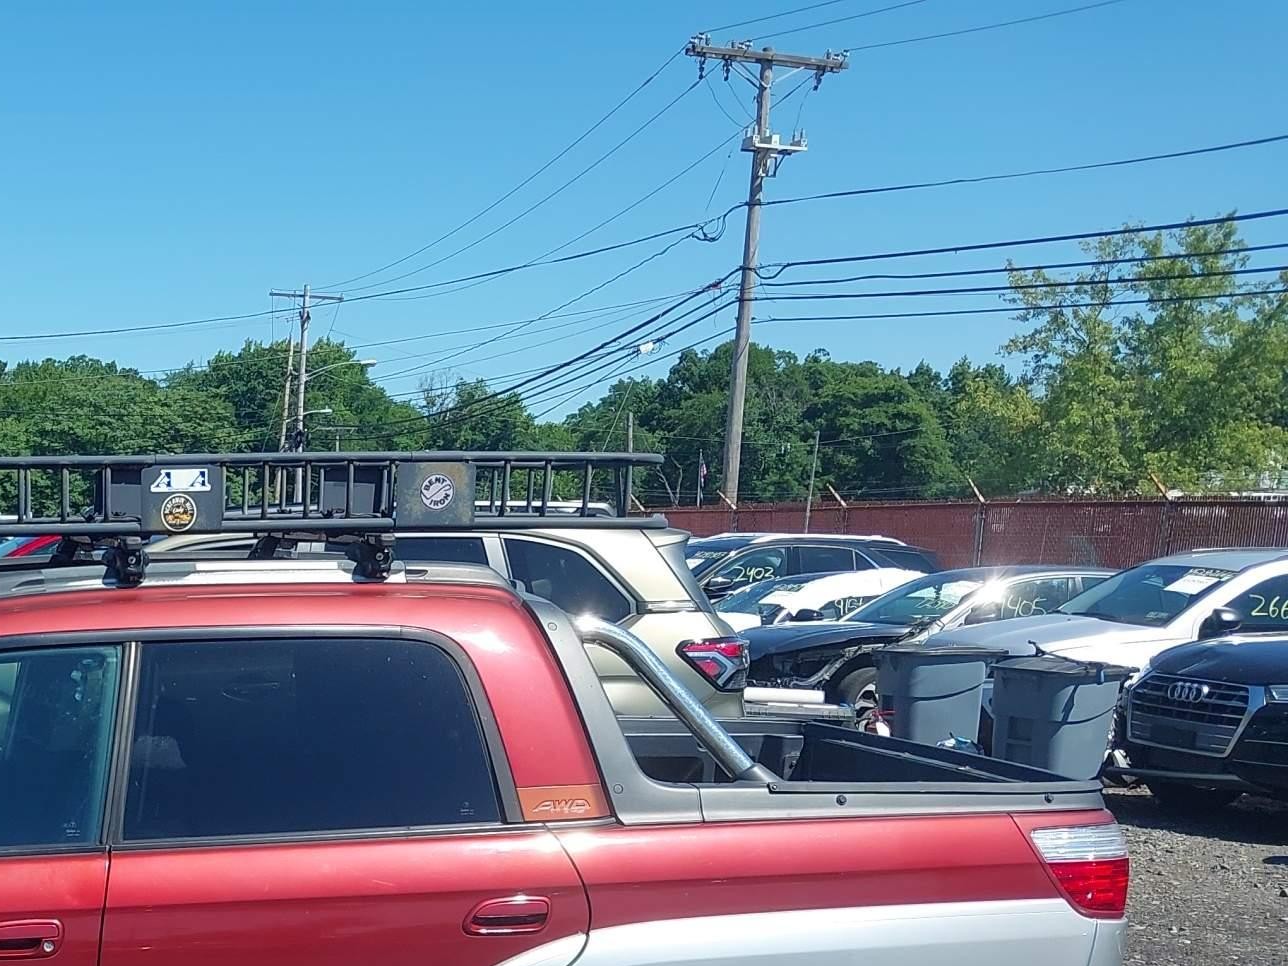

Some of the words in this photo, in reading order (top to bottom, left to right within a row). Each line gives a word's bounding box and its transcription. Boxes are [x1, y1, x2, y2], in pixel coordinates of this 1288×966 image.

[423, 477, 447, 491] BENT
[429, 492, 450, 507] IRON
[1001, 595, 1047, 619] 1405
[532, 799, 591, 813] AWD
